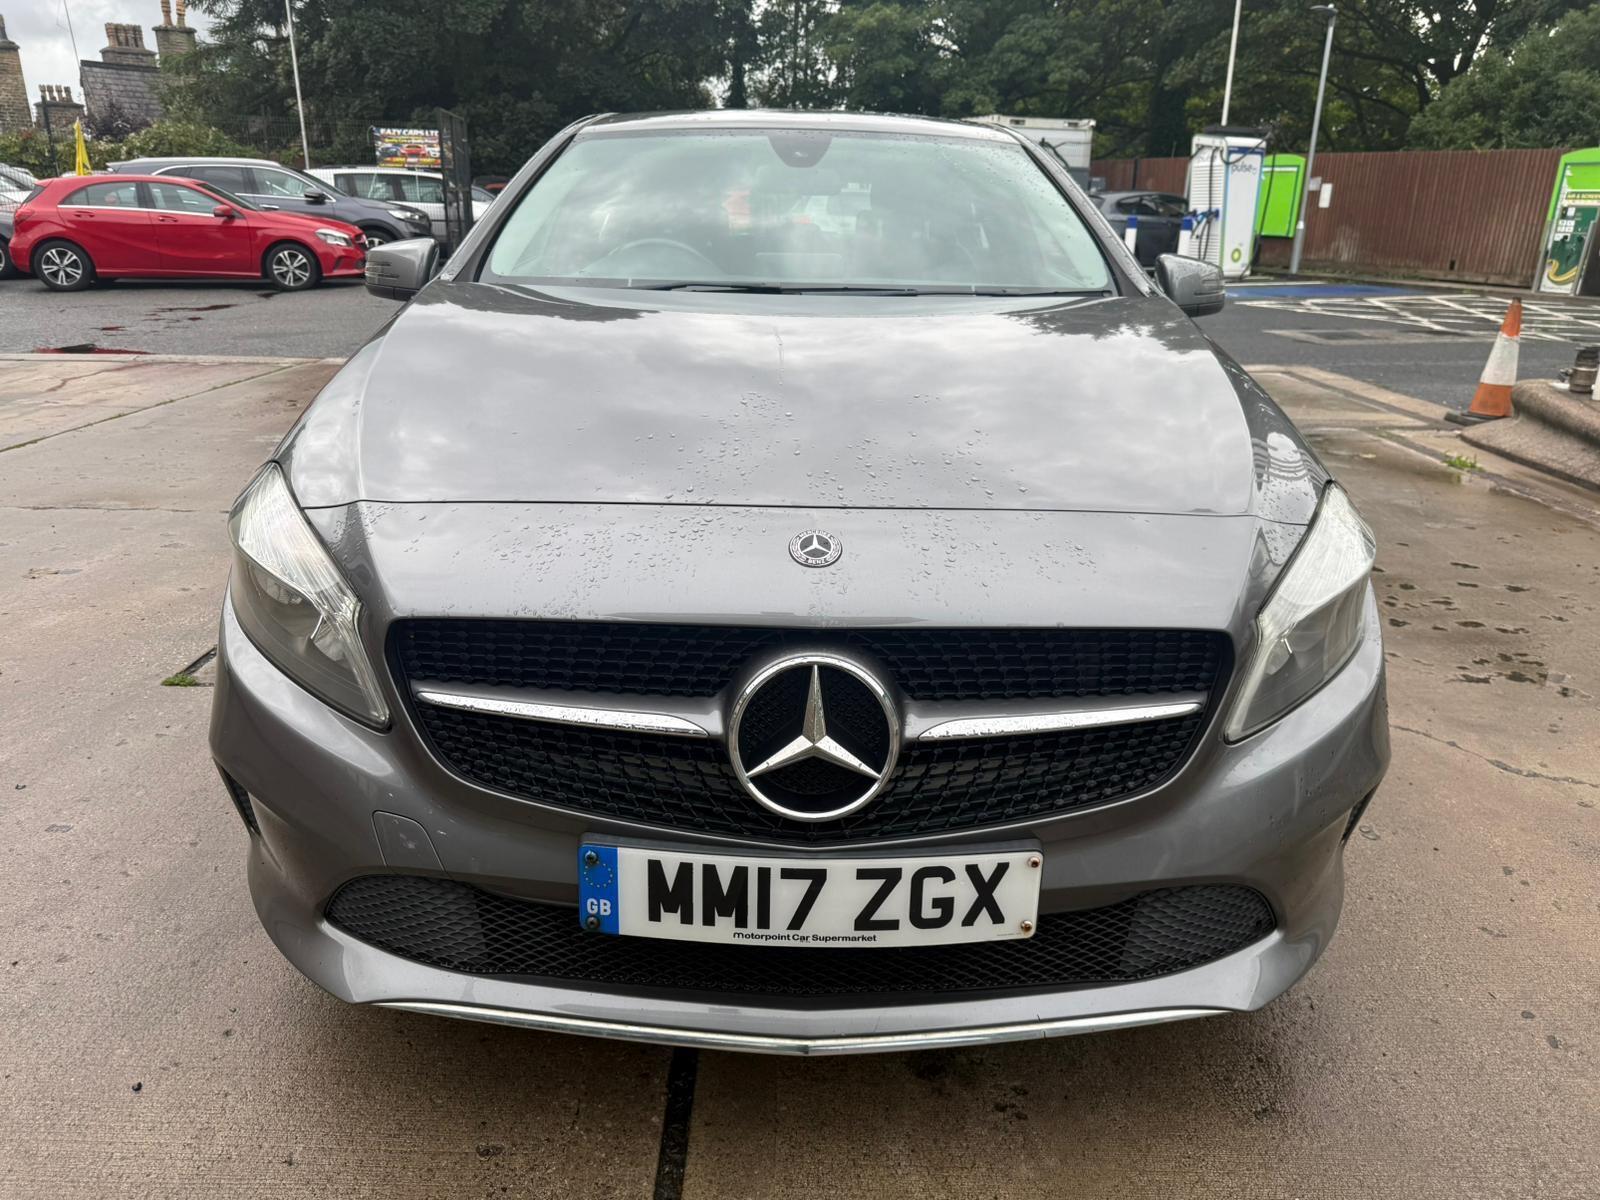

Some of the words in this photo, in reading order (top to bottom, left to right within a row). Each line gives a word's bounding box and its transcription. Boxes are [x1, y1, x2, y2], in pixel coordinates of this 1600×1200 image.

[647, 859, 828, 931] MM17
[854, 862, 1010, 932] ZGX
[586, 898, 612, 916] GB
[811, 934, 877, 943] Supermarket
